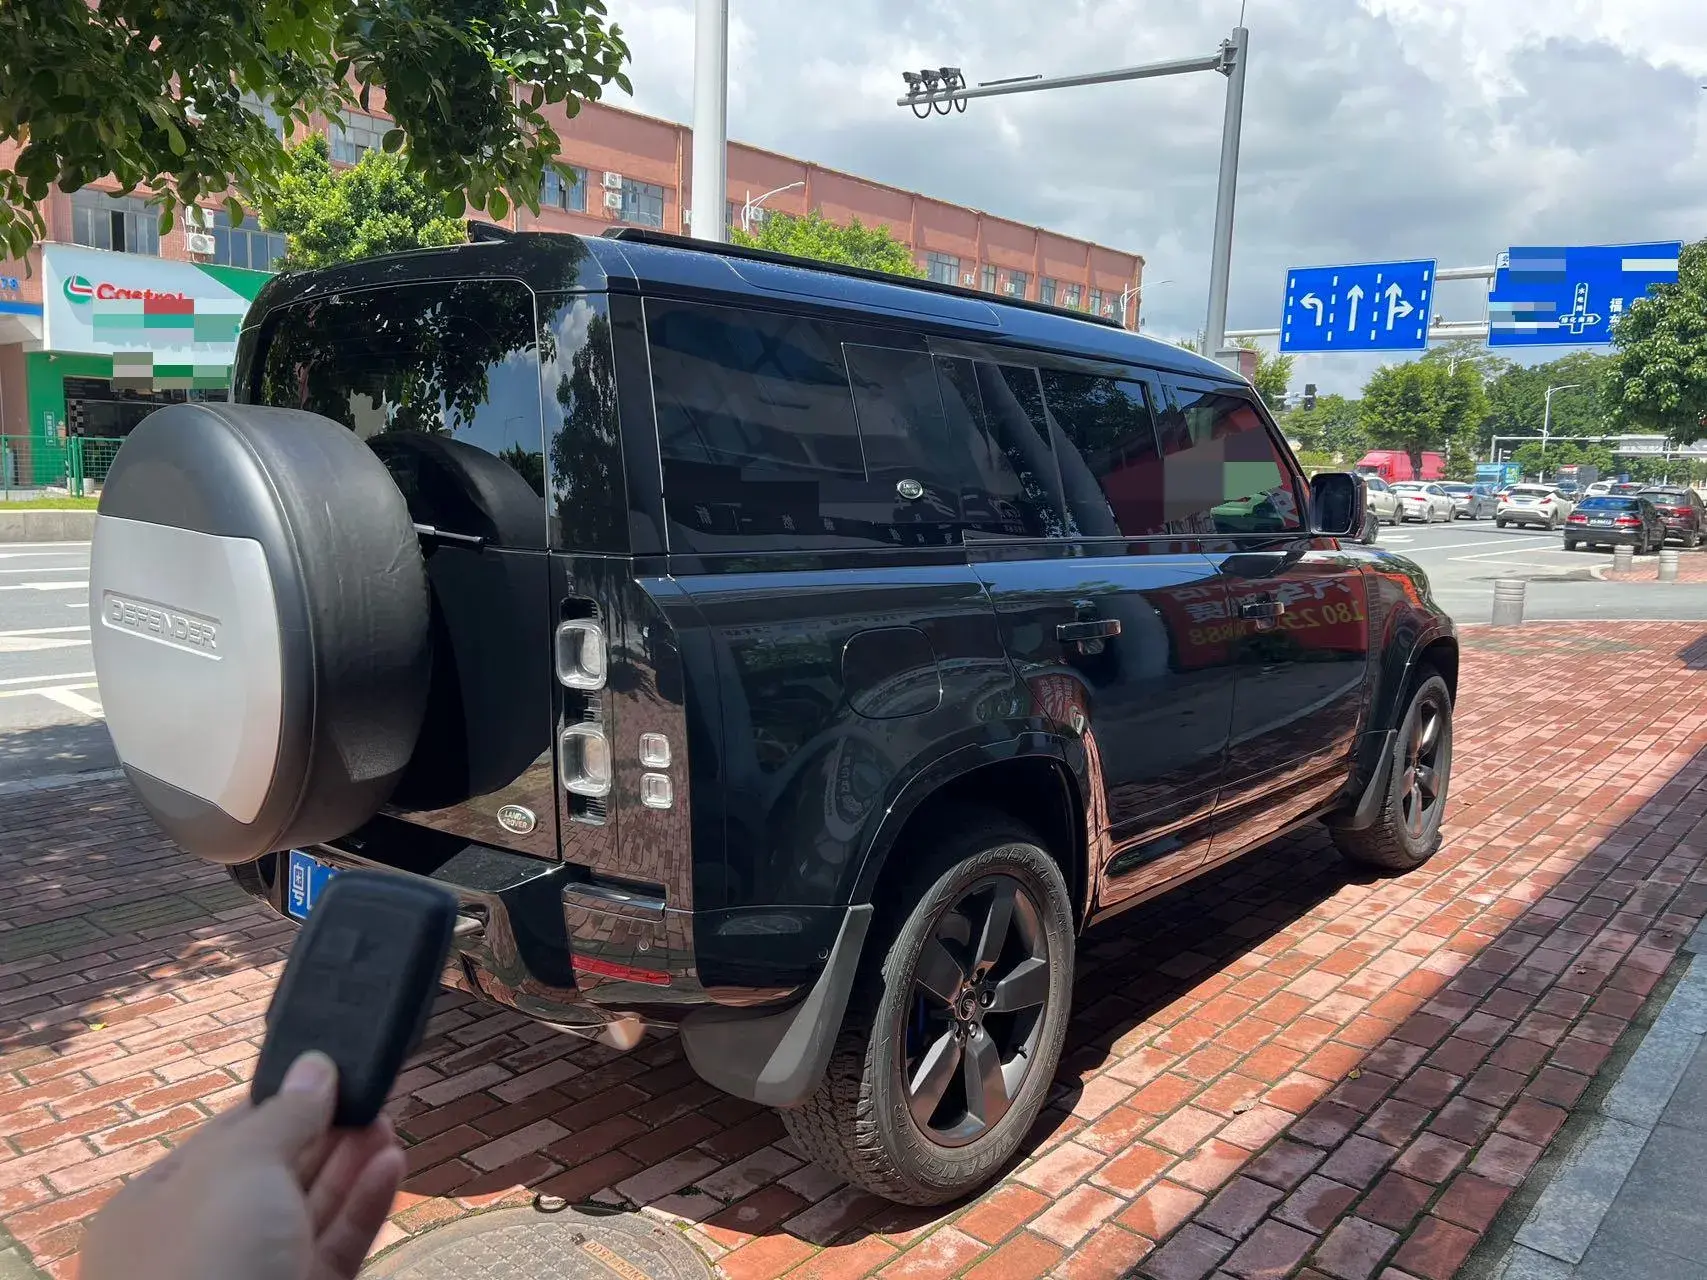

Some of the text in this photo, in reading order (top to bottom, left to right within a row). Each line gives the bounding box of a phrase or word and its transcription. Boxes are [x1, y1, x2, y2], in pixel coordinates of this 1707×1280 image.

[111, 599, 217, 649] DEFENDER
[504, 810, 523, 821] LAND
[505, 818, 528, 829] ROVER
